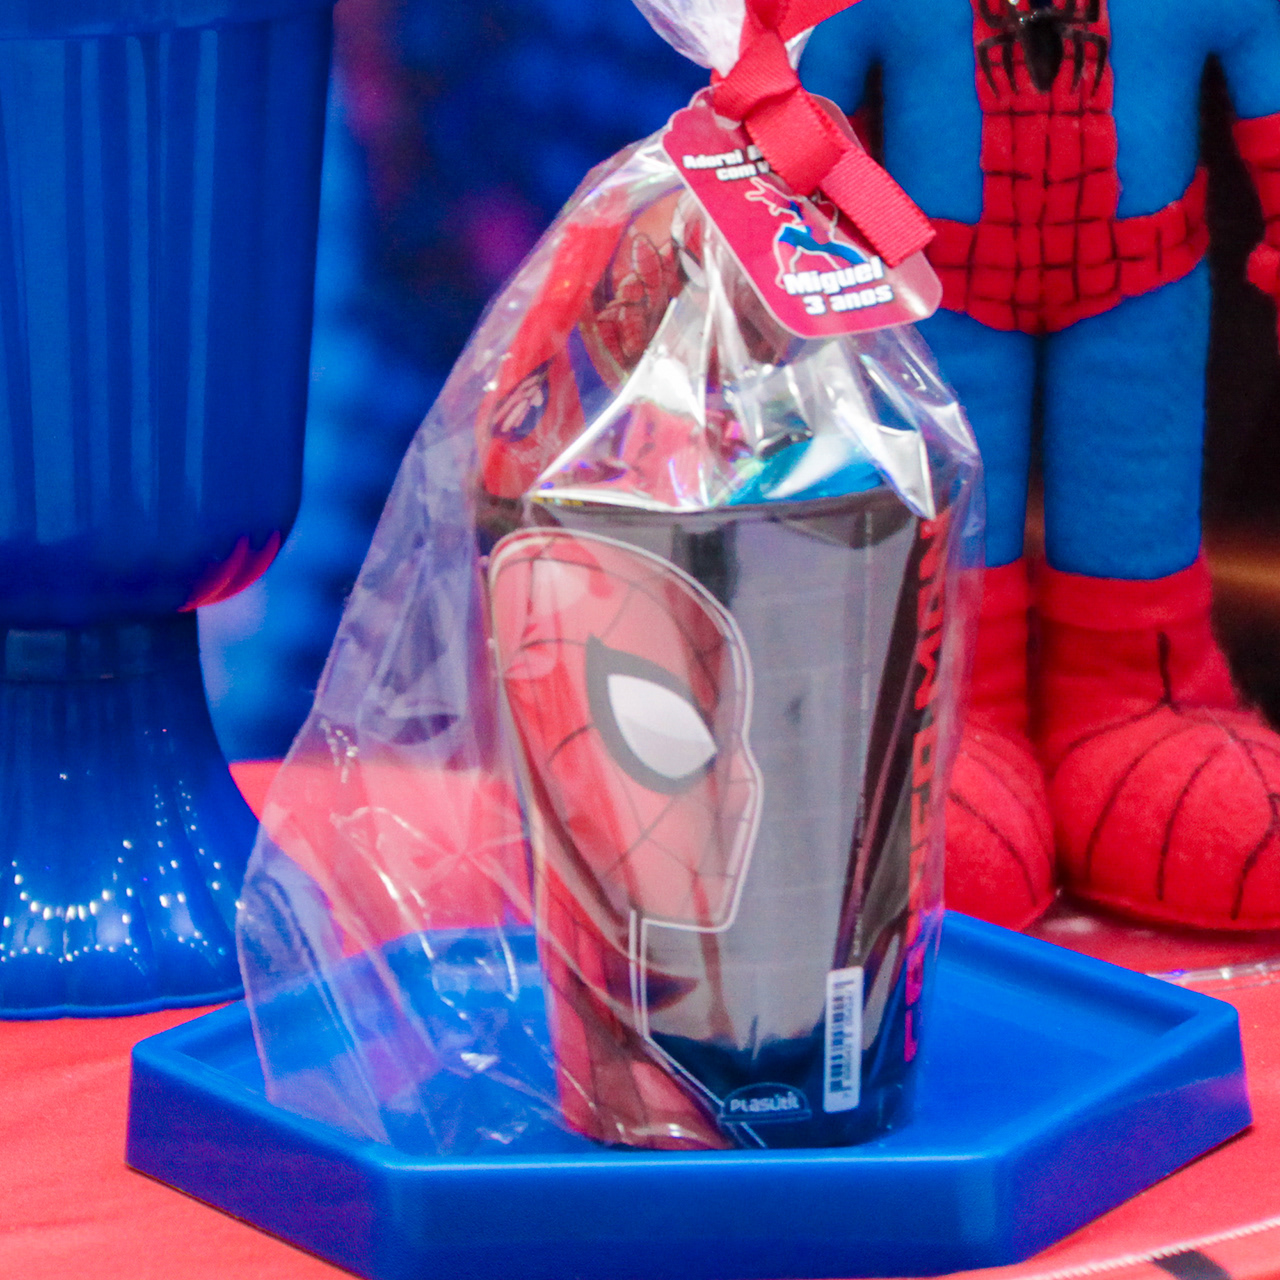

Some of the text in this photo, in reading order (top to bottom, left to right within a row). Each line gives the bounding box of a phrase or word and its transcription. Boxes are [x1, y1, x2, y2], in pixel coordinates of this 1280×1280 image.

[715, 163, 757, 182] com
[783, 255, 884, 296] Miguel
[803, 284, 894, 315] 3 anos
